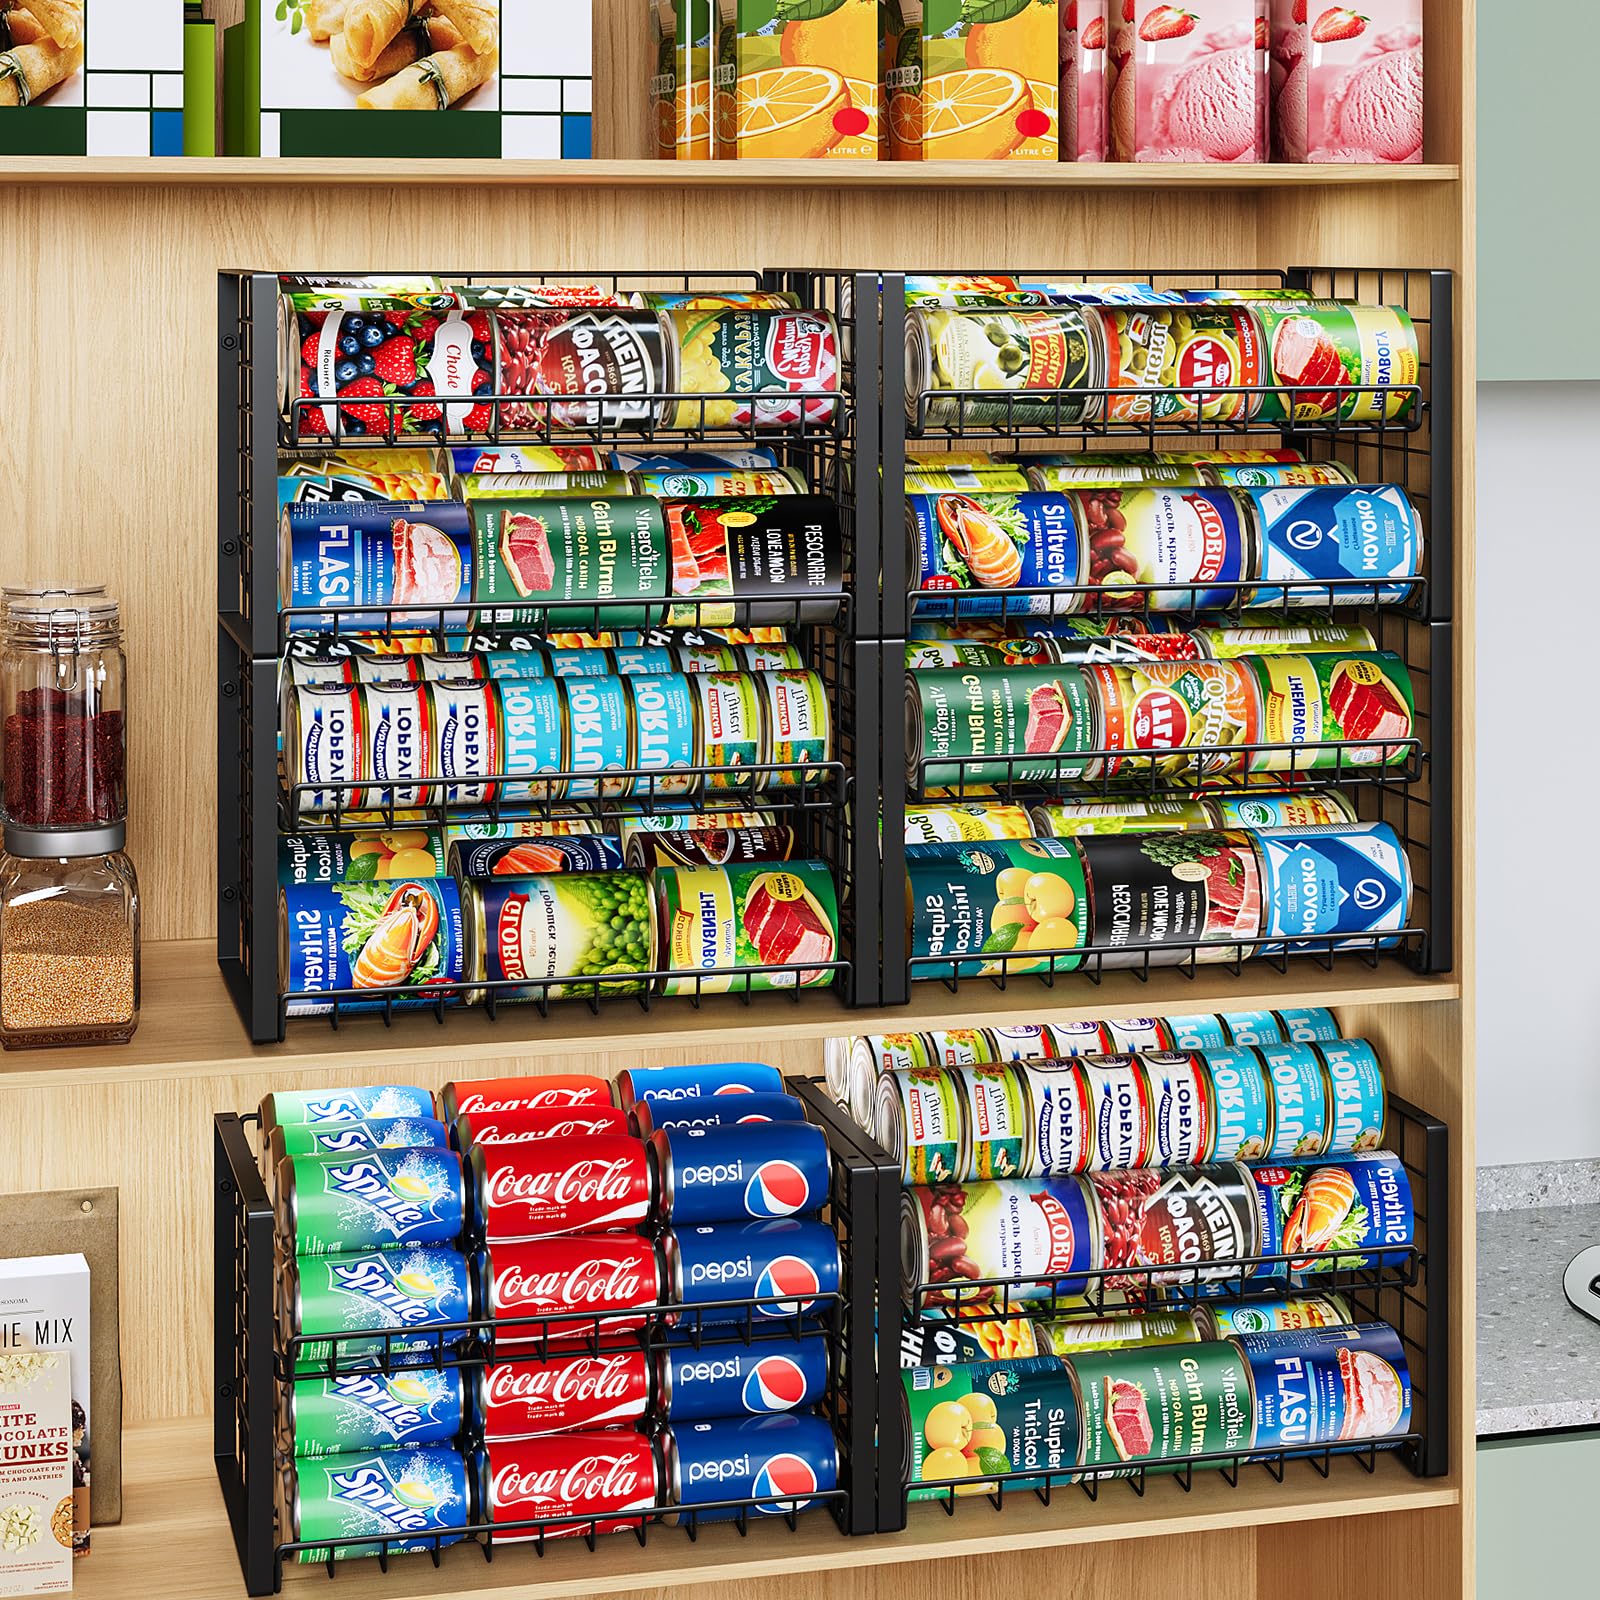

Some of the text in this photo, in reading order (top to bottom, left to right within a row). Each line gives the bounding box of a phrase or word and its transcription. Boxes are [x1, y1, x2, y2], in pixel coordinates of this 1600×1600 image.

[833, 147, 857, 155] LITRE
[1016, 148, 1040, 156] LITRE
[571, 328, 607, 424] ФАСОЬ
[606, 362, 617, 385] 1869
[1030, 340, 1048, 384] Oliva
[1162, 495, 1178, 583] Фасоль красна
[1193, 499, 1223, 582] GLOBUS
[1300, 857, 1317, 933] МОЛОКО
[329, 1163, 424, 1226] Sprite
[487, 1157, 634, 1208] Coca-Cola
[682, 1159, 743, 1189] pepsi
[1000, 1218, 1008, 1268] натуральная
[1009, 1195, 1024, 1289] Фасоль красня
[1200, 1229, 1211, 1251] 1869
[335, 1261, 429, 1322] Sprite
[493, 1256, 642, 1309] Coca-Cola
[690, 1255, 752, 1286] pepsi
[35, 1317, 73, 1346] MIX
[330, 1365, 424, 1427] Sprite
[486, 1354, 632, 1408] Coca-Cola
[680, 1356, 741, 1386] pepsi
[0, 1441, 68, 1461] UNKS
[7, 1467, 50, 1475] CHOCOLATE
[689, 1453, 750, 1485] pepsi
[335, 1468, 428, 1531] Sprite
[492, 1452, 640, 1508] Coca-Cola
